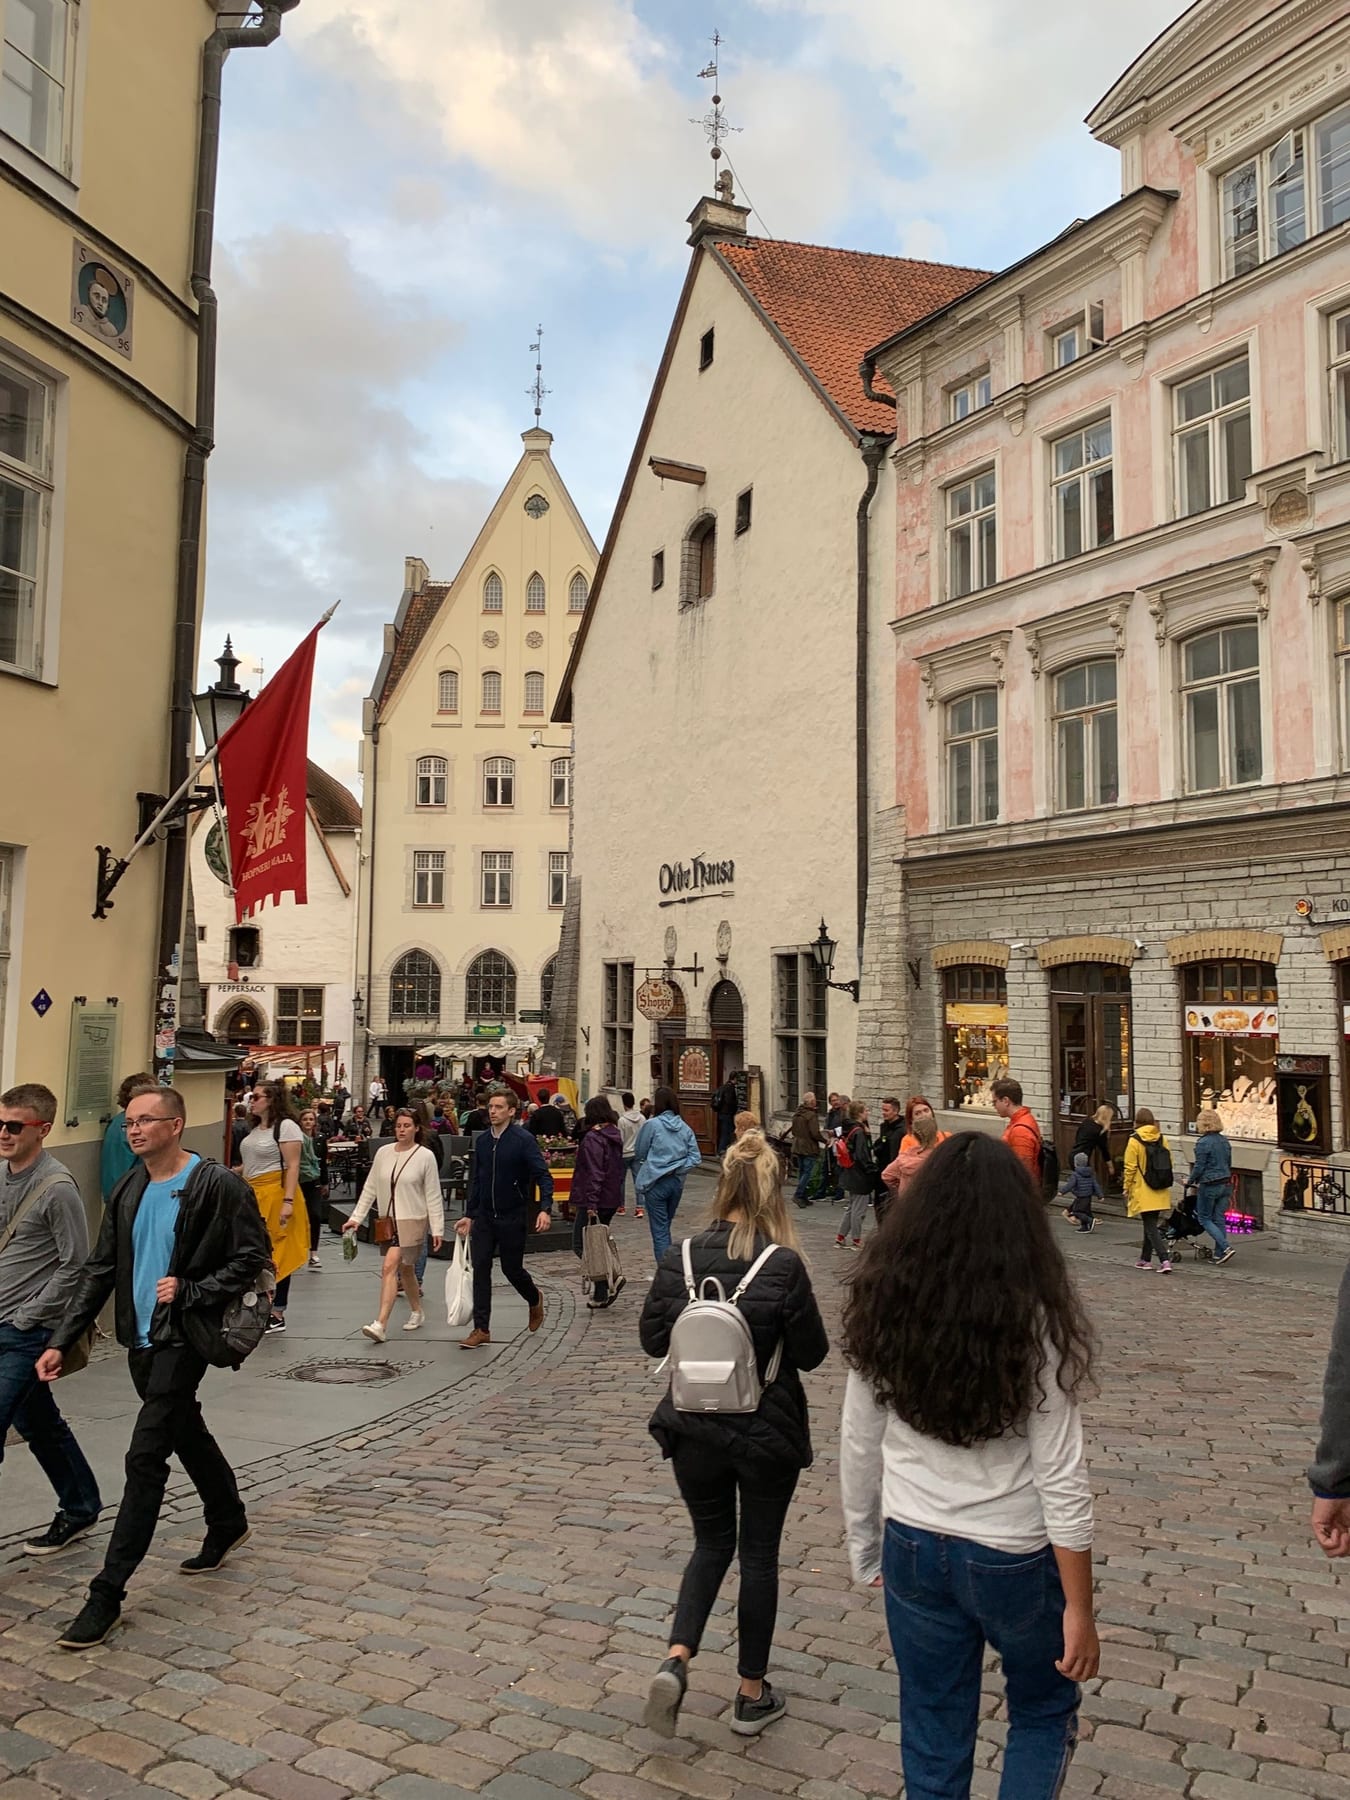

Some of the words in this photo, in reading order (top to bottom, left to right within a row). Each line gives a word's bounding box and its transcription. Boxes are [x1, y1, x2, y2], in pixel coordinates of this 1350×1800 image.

[659, 861, 690, 894] Olde
[689, 851, 735, 891] Hansa
[217, 984, 266, 993] PEPPERSACK
